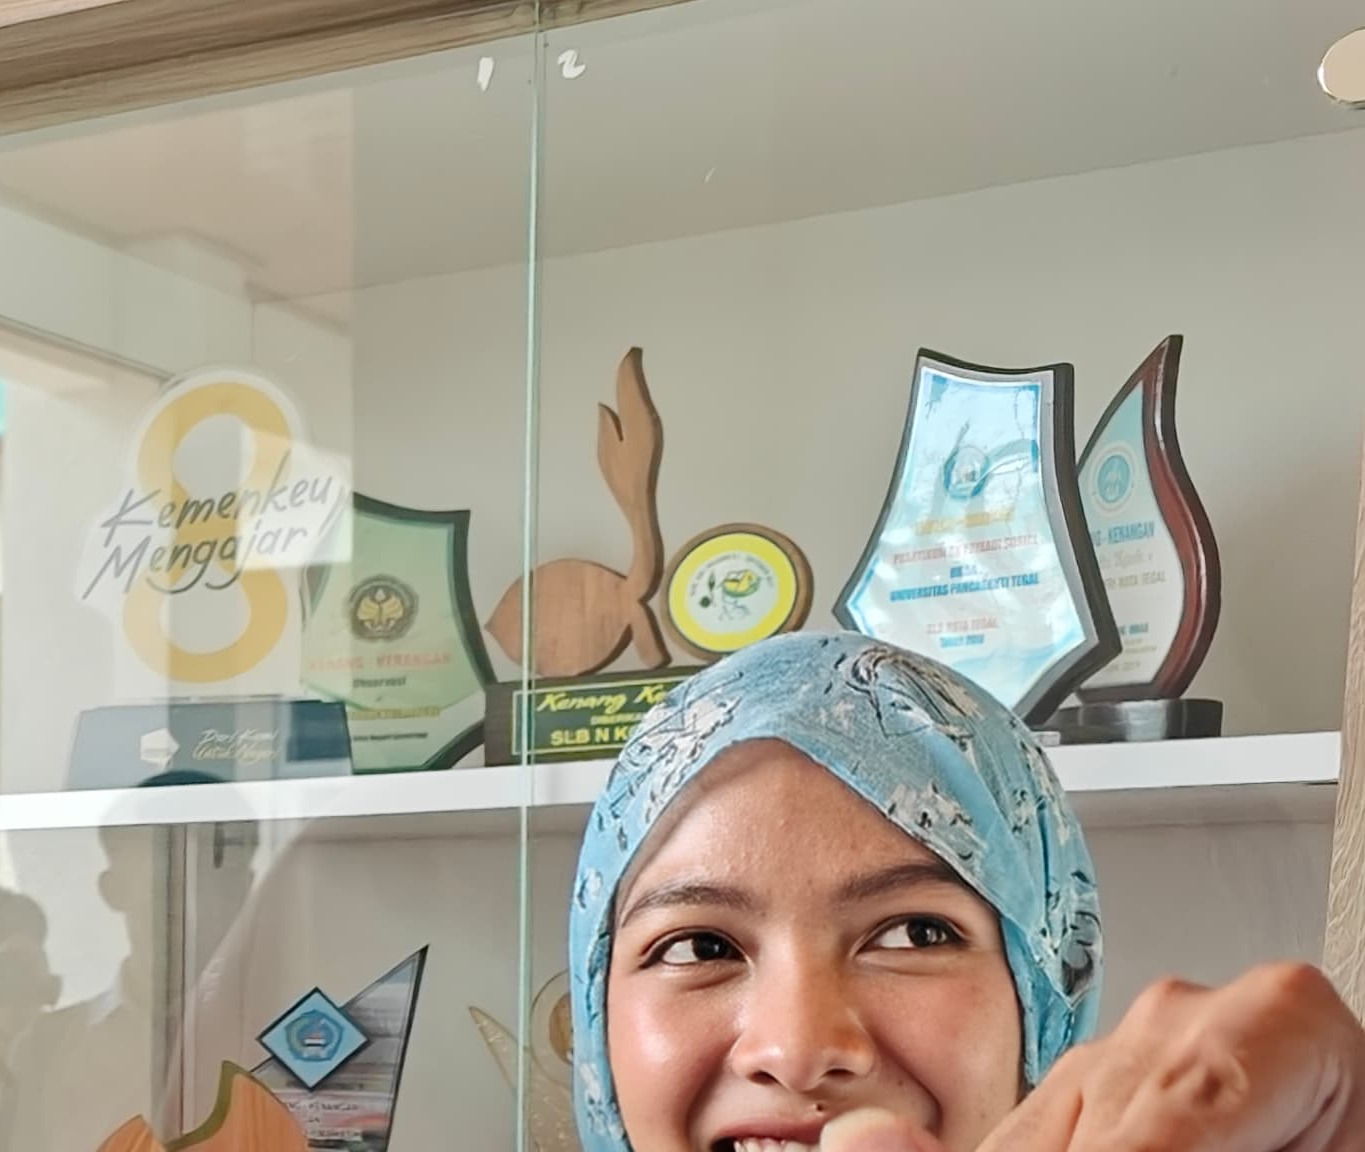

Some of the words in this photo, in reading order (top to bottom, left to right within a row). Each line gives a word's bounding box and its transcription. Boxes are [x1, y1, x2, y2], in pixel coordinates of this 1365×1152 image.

[557, 49, 586, 79] 2
[101, 450, 333, 546] Kemenkeu
[83, 520, 309, 600] Mengajar
[537, 692, 628, 715] Kenang
[550, 729, 590, 746] SLB
[595, 727, 610, 743] N
